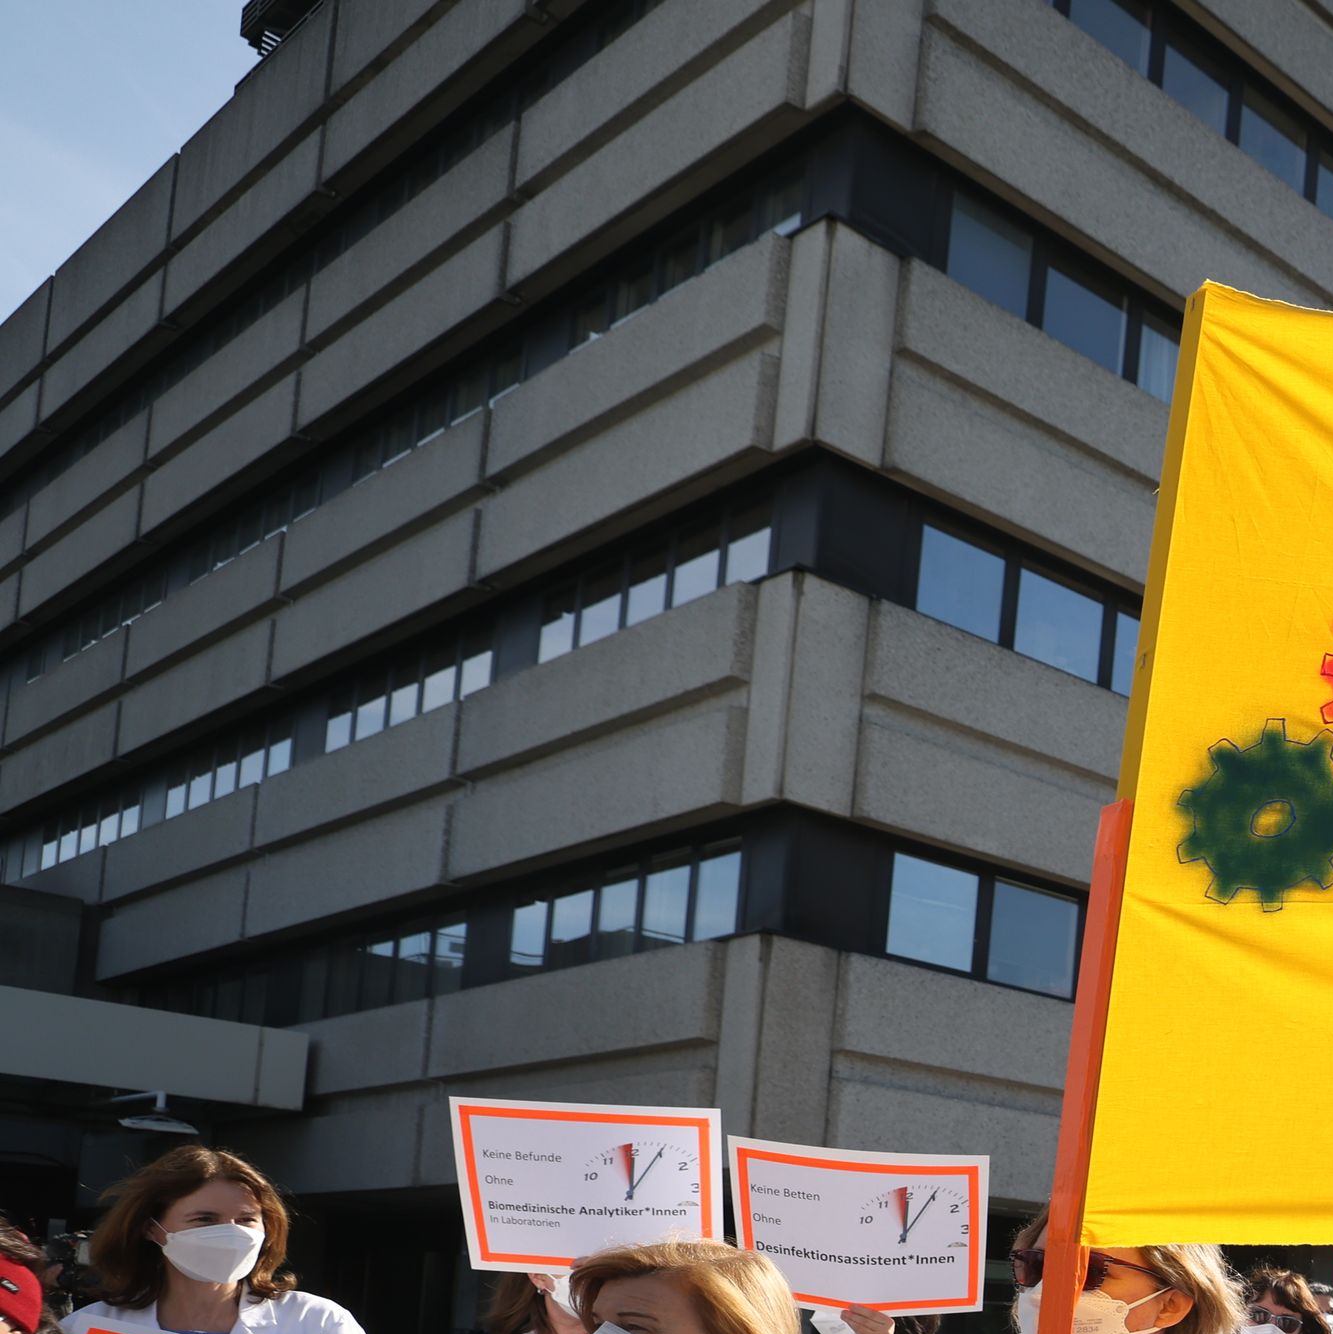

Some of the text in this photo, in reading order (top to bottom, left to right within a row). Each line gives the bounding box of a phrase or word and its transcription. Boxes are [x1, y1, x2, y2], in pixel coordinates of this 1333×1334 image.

[482, 1149, 562, 1163] Keine Befunde
[678, 1161, 689, 1171] 2
[485, 1175, 514, 1186] Ohne
[584, 1172, 598, 1181] 10
[691, 1183, 700, 1193] 3
[750, 1183, 820, 1202] Keine Betten
[488, 1200, 576, 1216] Biomedizinische
[950, 1204, 960, 1214] 2
[490, 1215, 561, 1228] In Laboratorien
[753, 1213, 782, 1226] Ohne
[859, 1215, 873, 1225] 10
[960, 1224, 969, 1235] 3
